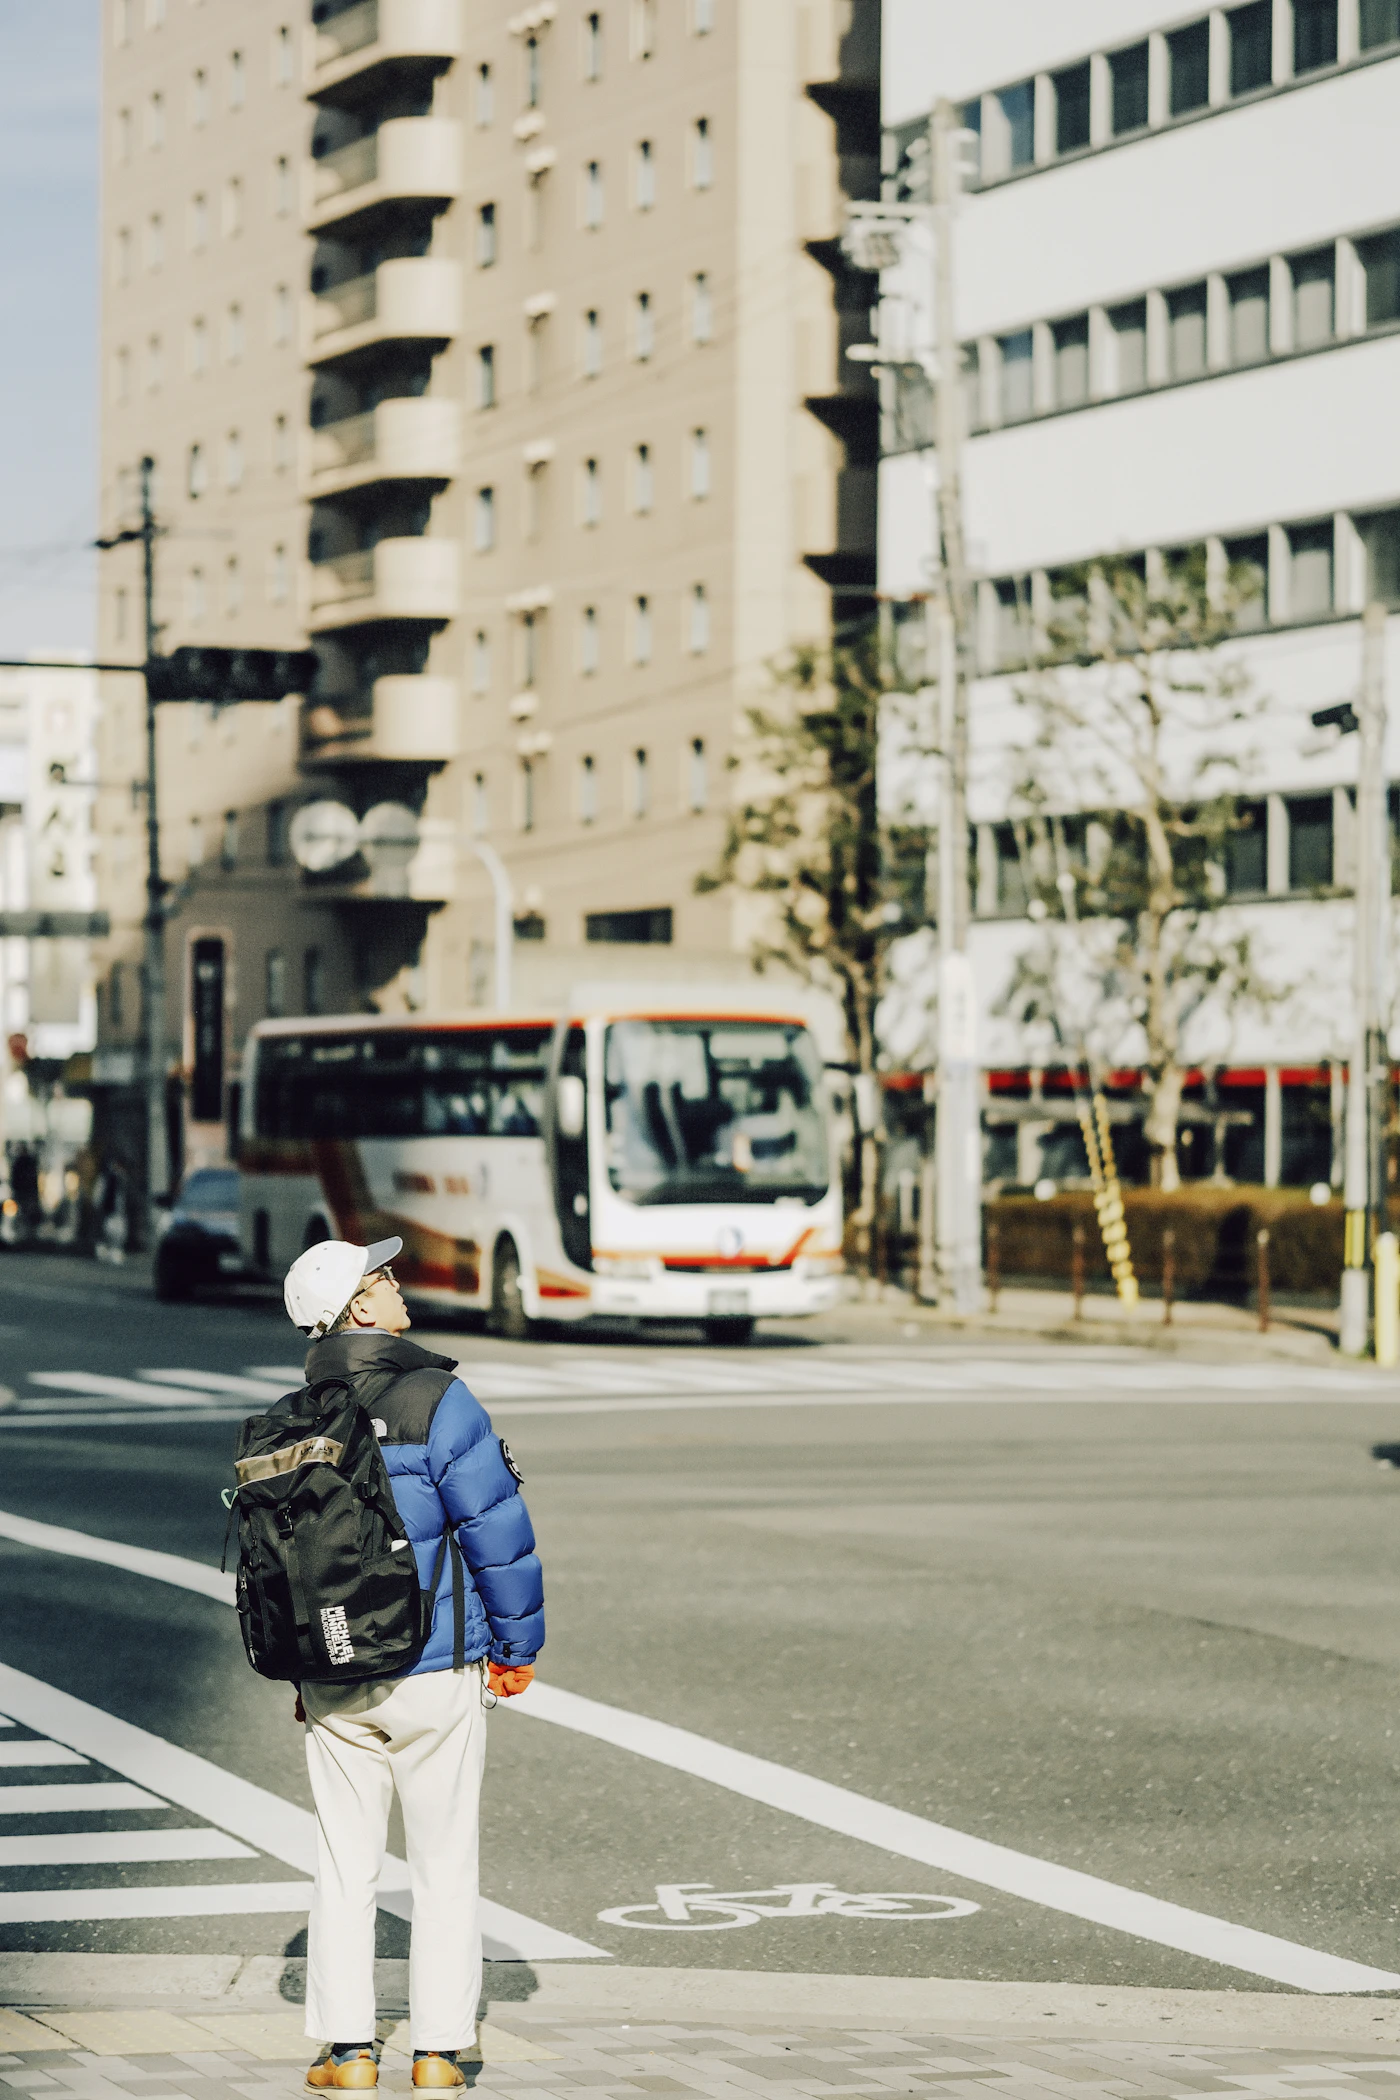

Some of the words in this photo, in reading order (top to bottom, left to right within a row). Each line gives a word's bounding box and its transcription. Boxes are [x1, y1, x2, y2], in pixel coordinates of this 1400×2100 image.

[320, 1608, 331, 1640] MAILROOM
[326, 1607, 346, 1665] LINNELL'S
[334, 1605, 355, 1663] MICHAEL
